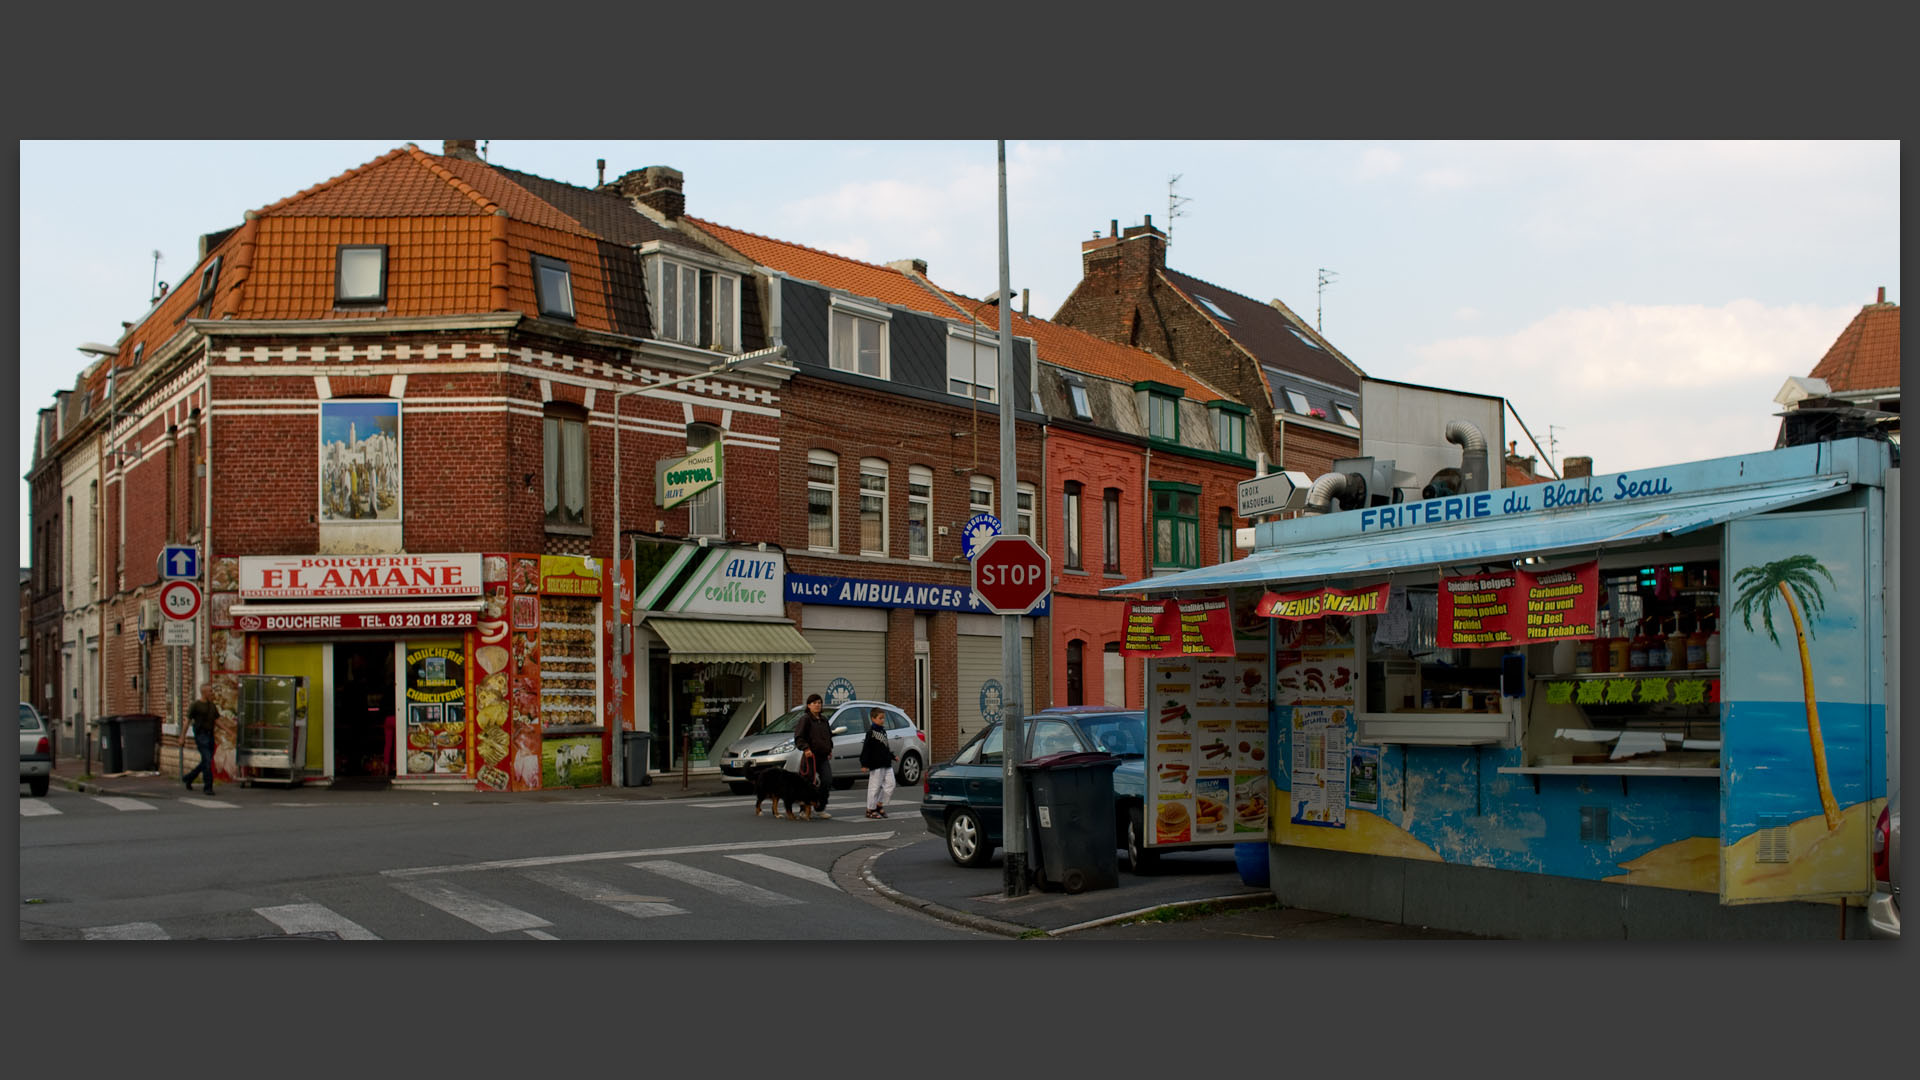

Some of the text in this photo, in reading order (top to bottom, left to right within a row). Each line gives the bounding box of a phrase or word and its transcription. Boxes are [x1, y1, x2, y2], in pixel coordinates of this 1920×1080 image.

[688, 456, 714, 466] HOMMES
[664, 488, 684, 499] ALIVE
[1241, 486, 1259, 497] CROIX
[1241, 496, 1275, 509] WASQUEHAL
[1361, 474, 1672, 532] FRITERIE du Blanc Seau
[301, 557, 423, 568] BOUCHERIE
[725, 558, 776, 580] ALIVE
[262, 566, 462, 588] EL AMANE
[982, 564, 1042, 585] STOP
[244, 586, 480, 597] BOUCHERIE CHARCUTERIE TRAITEUR
[705, 581, 767, 604] coiffure
[839, 582, 962, 608] AMBULANCES
[1529, 584, 1583, 599] Carbonnades
[170, 595, 191, 607] 3,5t
[1270, 595, 1320, 616] MENUS
[1528, 598, 1574, 611] Vol au vent
[266, 615, 341, 629] BOUCHERIE
[389, 614, 403, 626] 03
[406, 614, 420, 626] 20
[423, 614, 436, 626] 01
[440, 613, 454, 625] 82
[457, 613, 472, 625] 28
[1528, 613, 1563, 625] Big Best
[1528, 627, 1547, 638] Pitta
[1548, 625, 1575, 637] Kebab
[407, 648, 464, 665] BOUCHERIE
[407, 686, 465, 702] CHARCUTERIE
